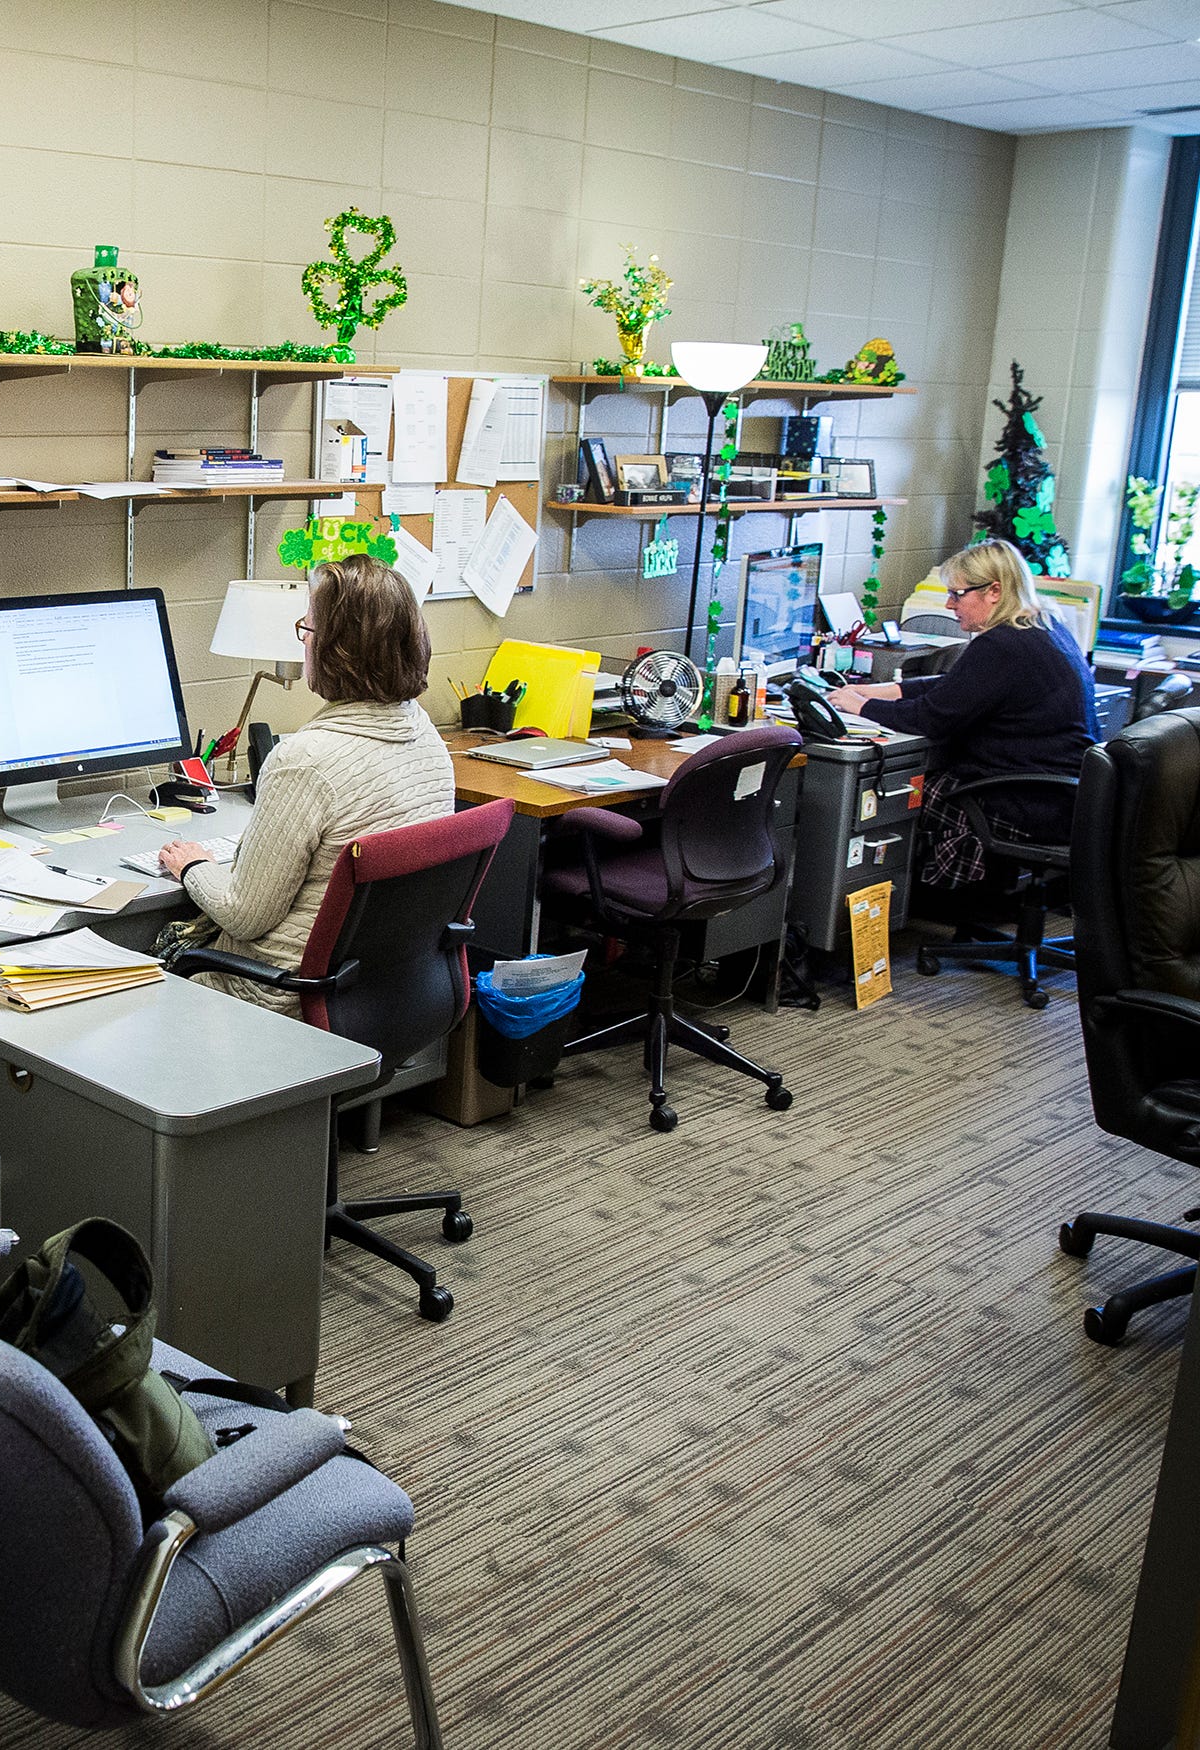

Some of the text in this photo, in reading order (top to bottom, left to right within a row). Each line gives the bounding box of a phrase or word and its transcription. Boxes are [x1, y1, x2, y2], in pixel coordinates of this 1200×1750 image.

[311, 520, 371, 543] LUCK
[321, 542, 354, 560] of the
